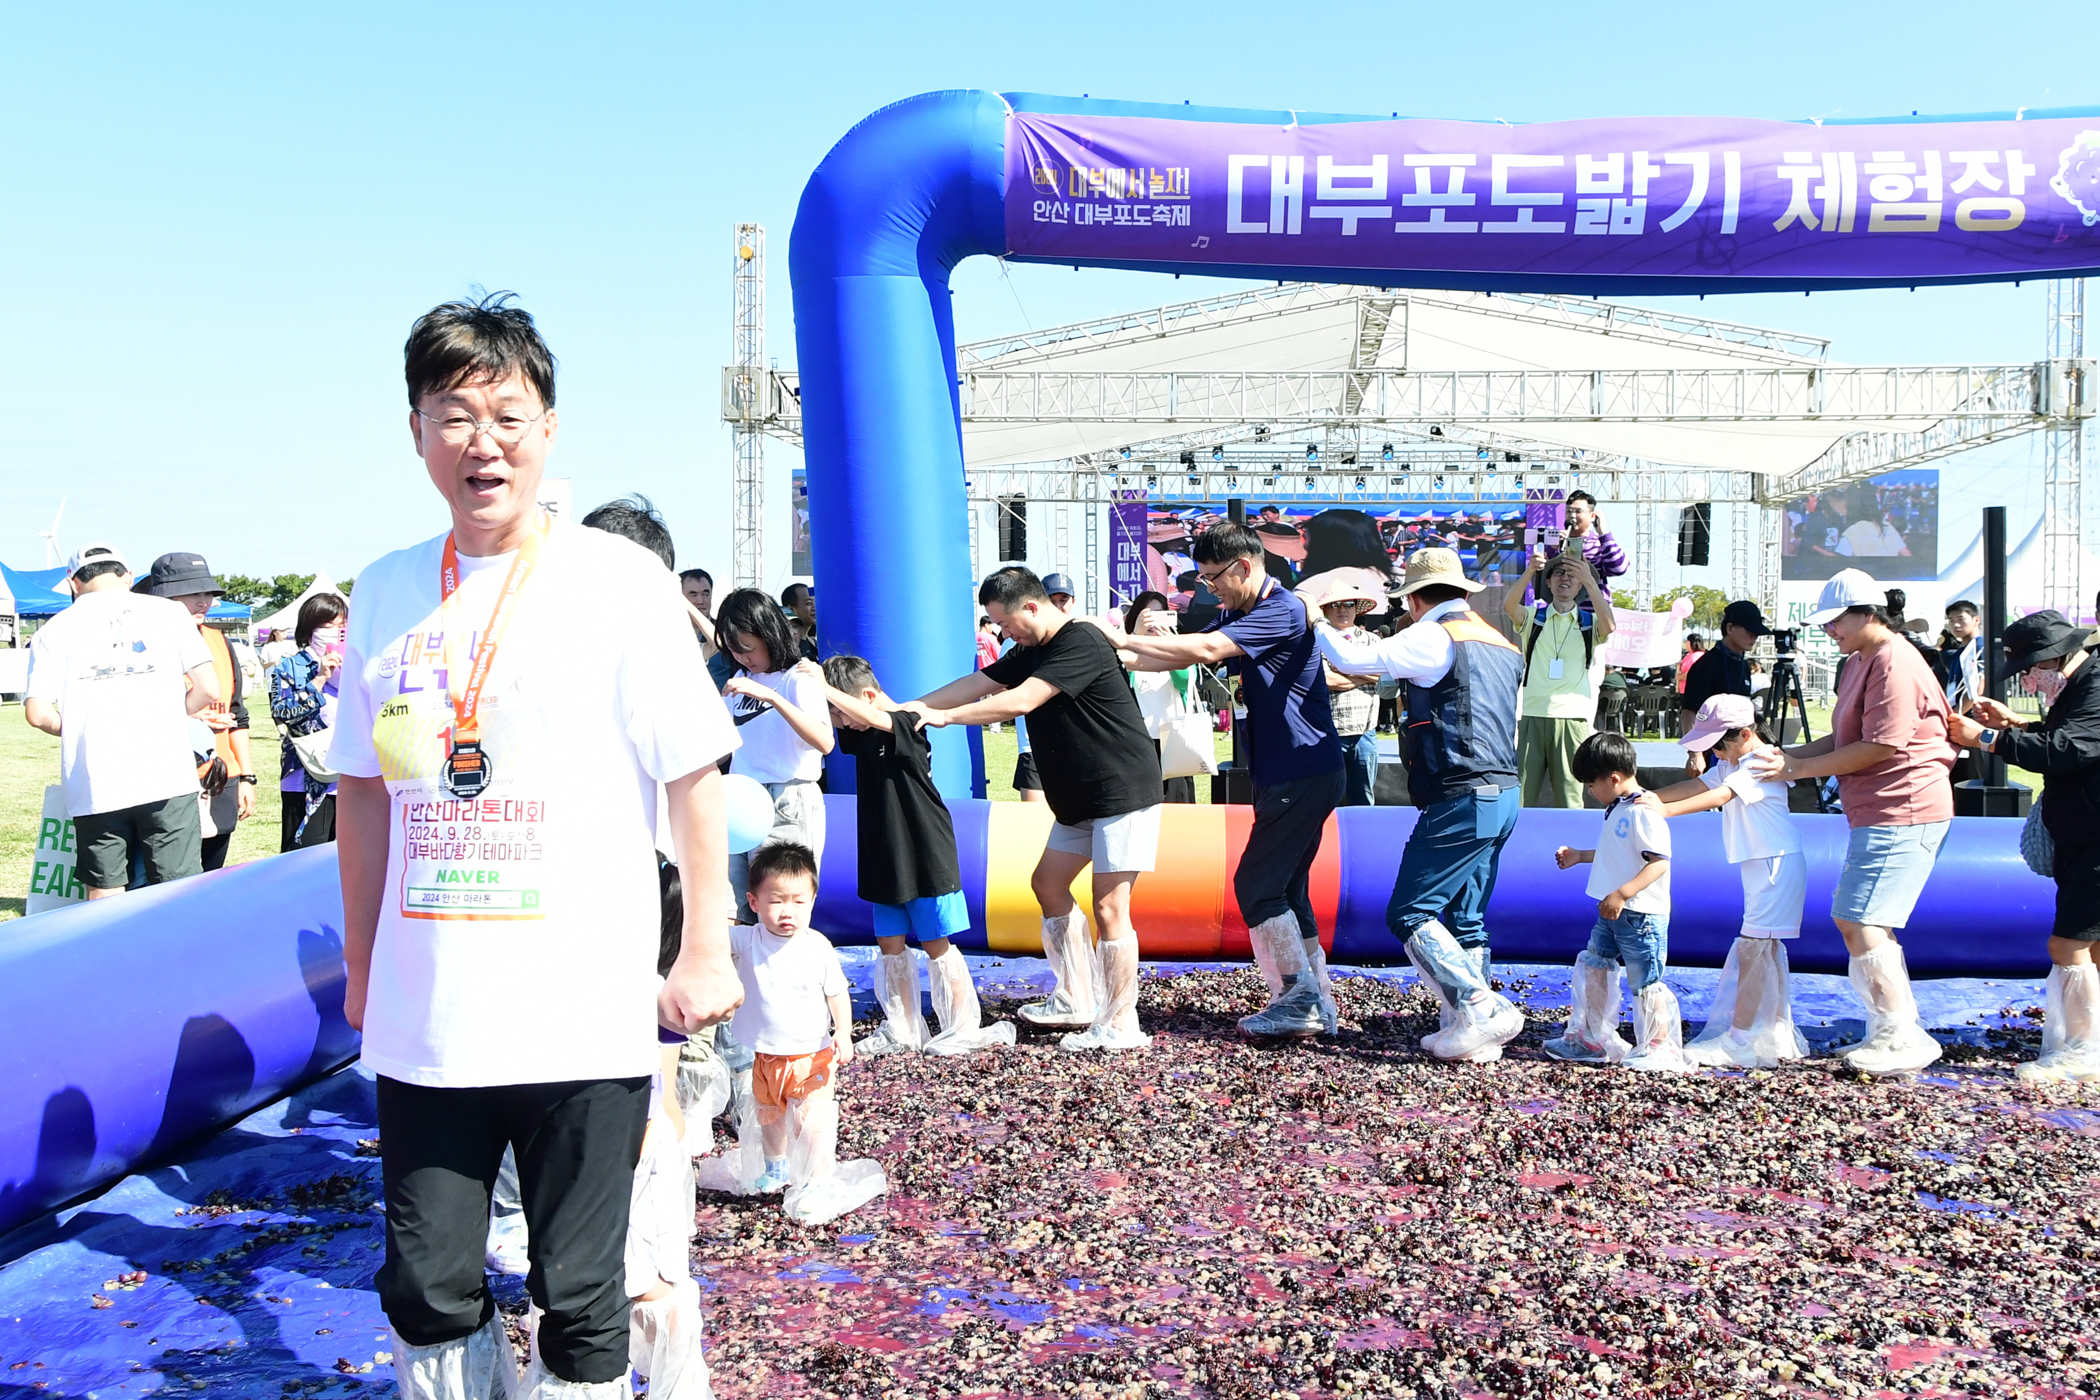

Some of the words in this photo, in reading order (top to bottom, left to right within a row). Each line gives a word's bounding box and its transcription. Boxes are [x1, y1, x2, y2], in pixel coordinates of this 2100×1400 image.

[1069, 166, 1145, 200] 대부에서
[1149, 166, 1191, 200] 놀자!
[1226, 151, 1741, 236] 대부포도밟기
[1772, 149, 2036, 233] 체험장
[1033, 200, 1070, 224] 안산
[1075, 203, 1191, 227] 대부포도축제
[1117, 542, 1141, 561] 대부
[444, 567, 456, 593] 2024
[1117, 562, 1141, 582] 에서
[381, 656, 399, 672] 2024
[470, 644, 494, 689] Festival
[463, 690, 477, 718] 2024
[410, 799, 545, 823] 안산마라톤대회
[38, 817, 78, 853] RE
[409, 826, 444, 841] 2024.
[448, 826, 460, 841] 9.
[409, 842, 542, 861] 대부바다향기테마파크
[436, 869, 500, 884] NAVER
[421, 893, 440, 903] 2024
[442, 893, 460, 904] 안산
[463, 893, 492, 905] 마라톤
